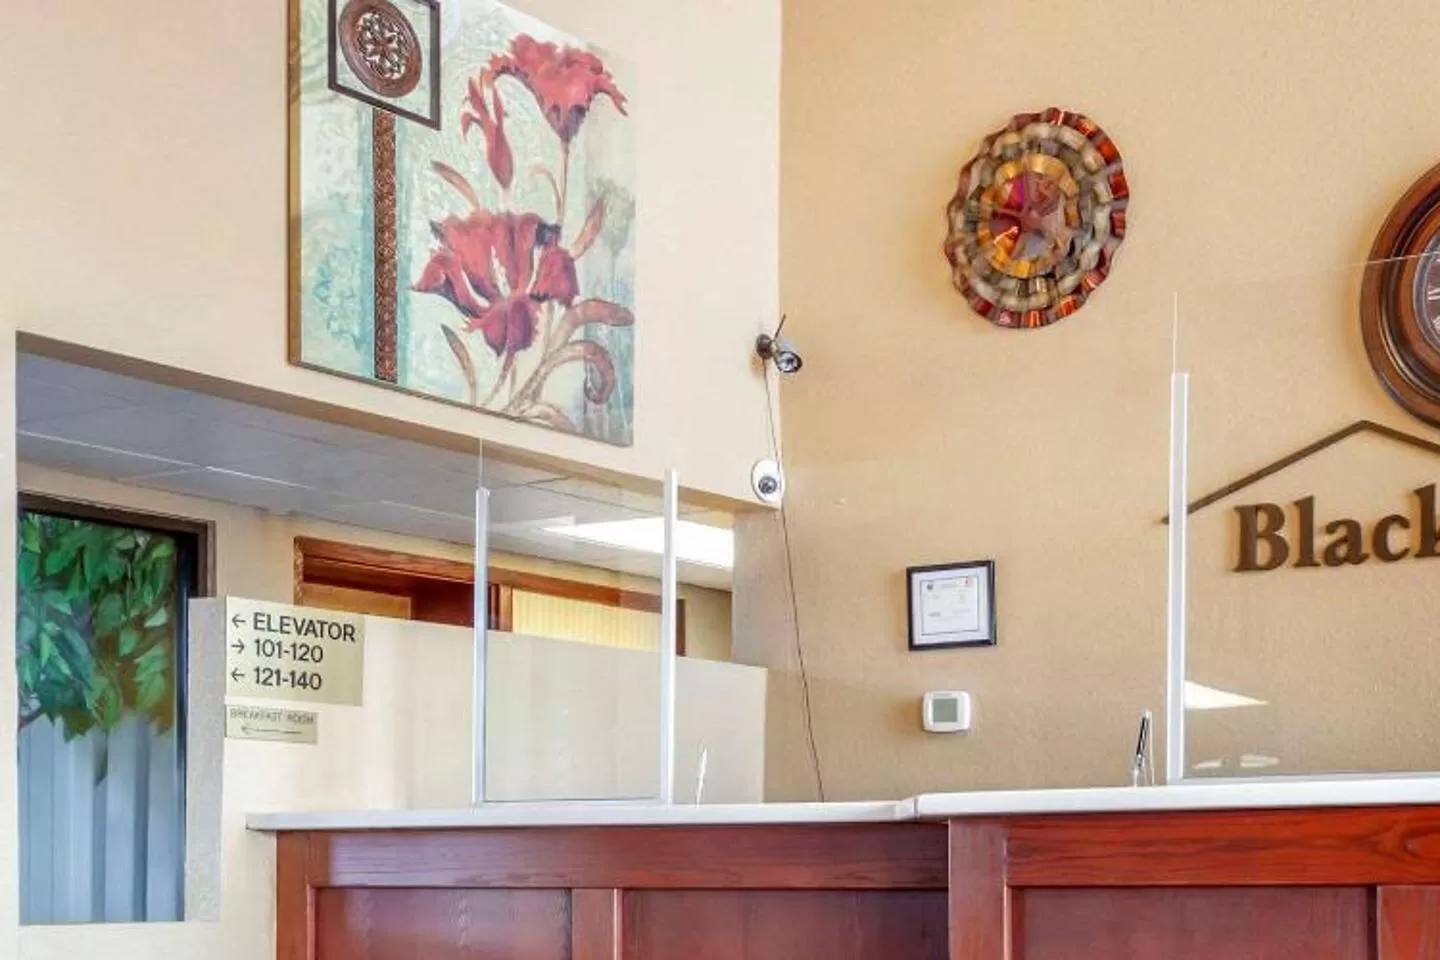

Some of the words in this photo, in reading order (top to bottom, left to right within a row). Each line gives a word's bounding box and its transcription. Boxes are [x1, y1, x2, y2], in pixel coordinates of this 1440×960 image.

[253, 612, 356, 642] ELEVATOR
[254, 637, 324, 663] 101-120
[254, 666, 322, 690] 121-140
